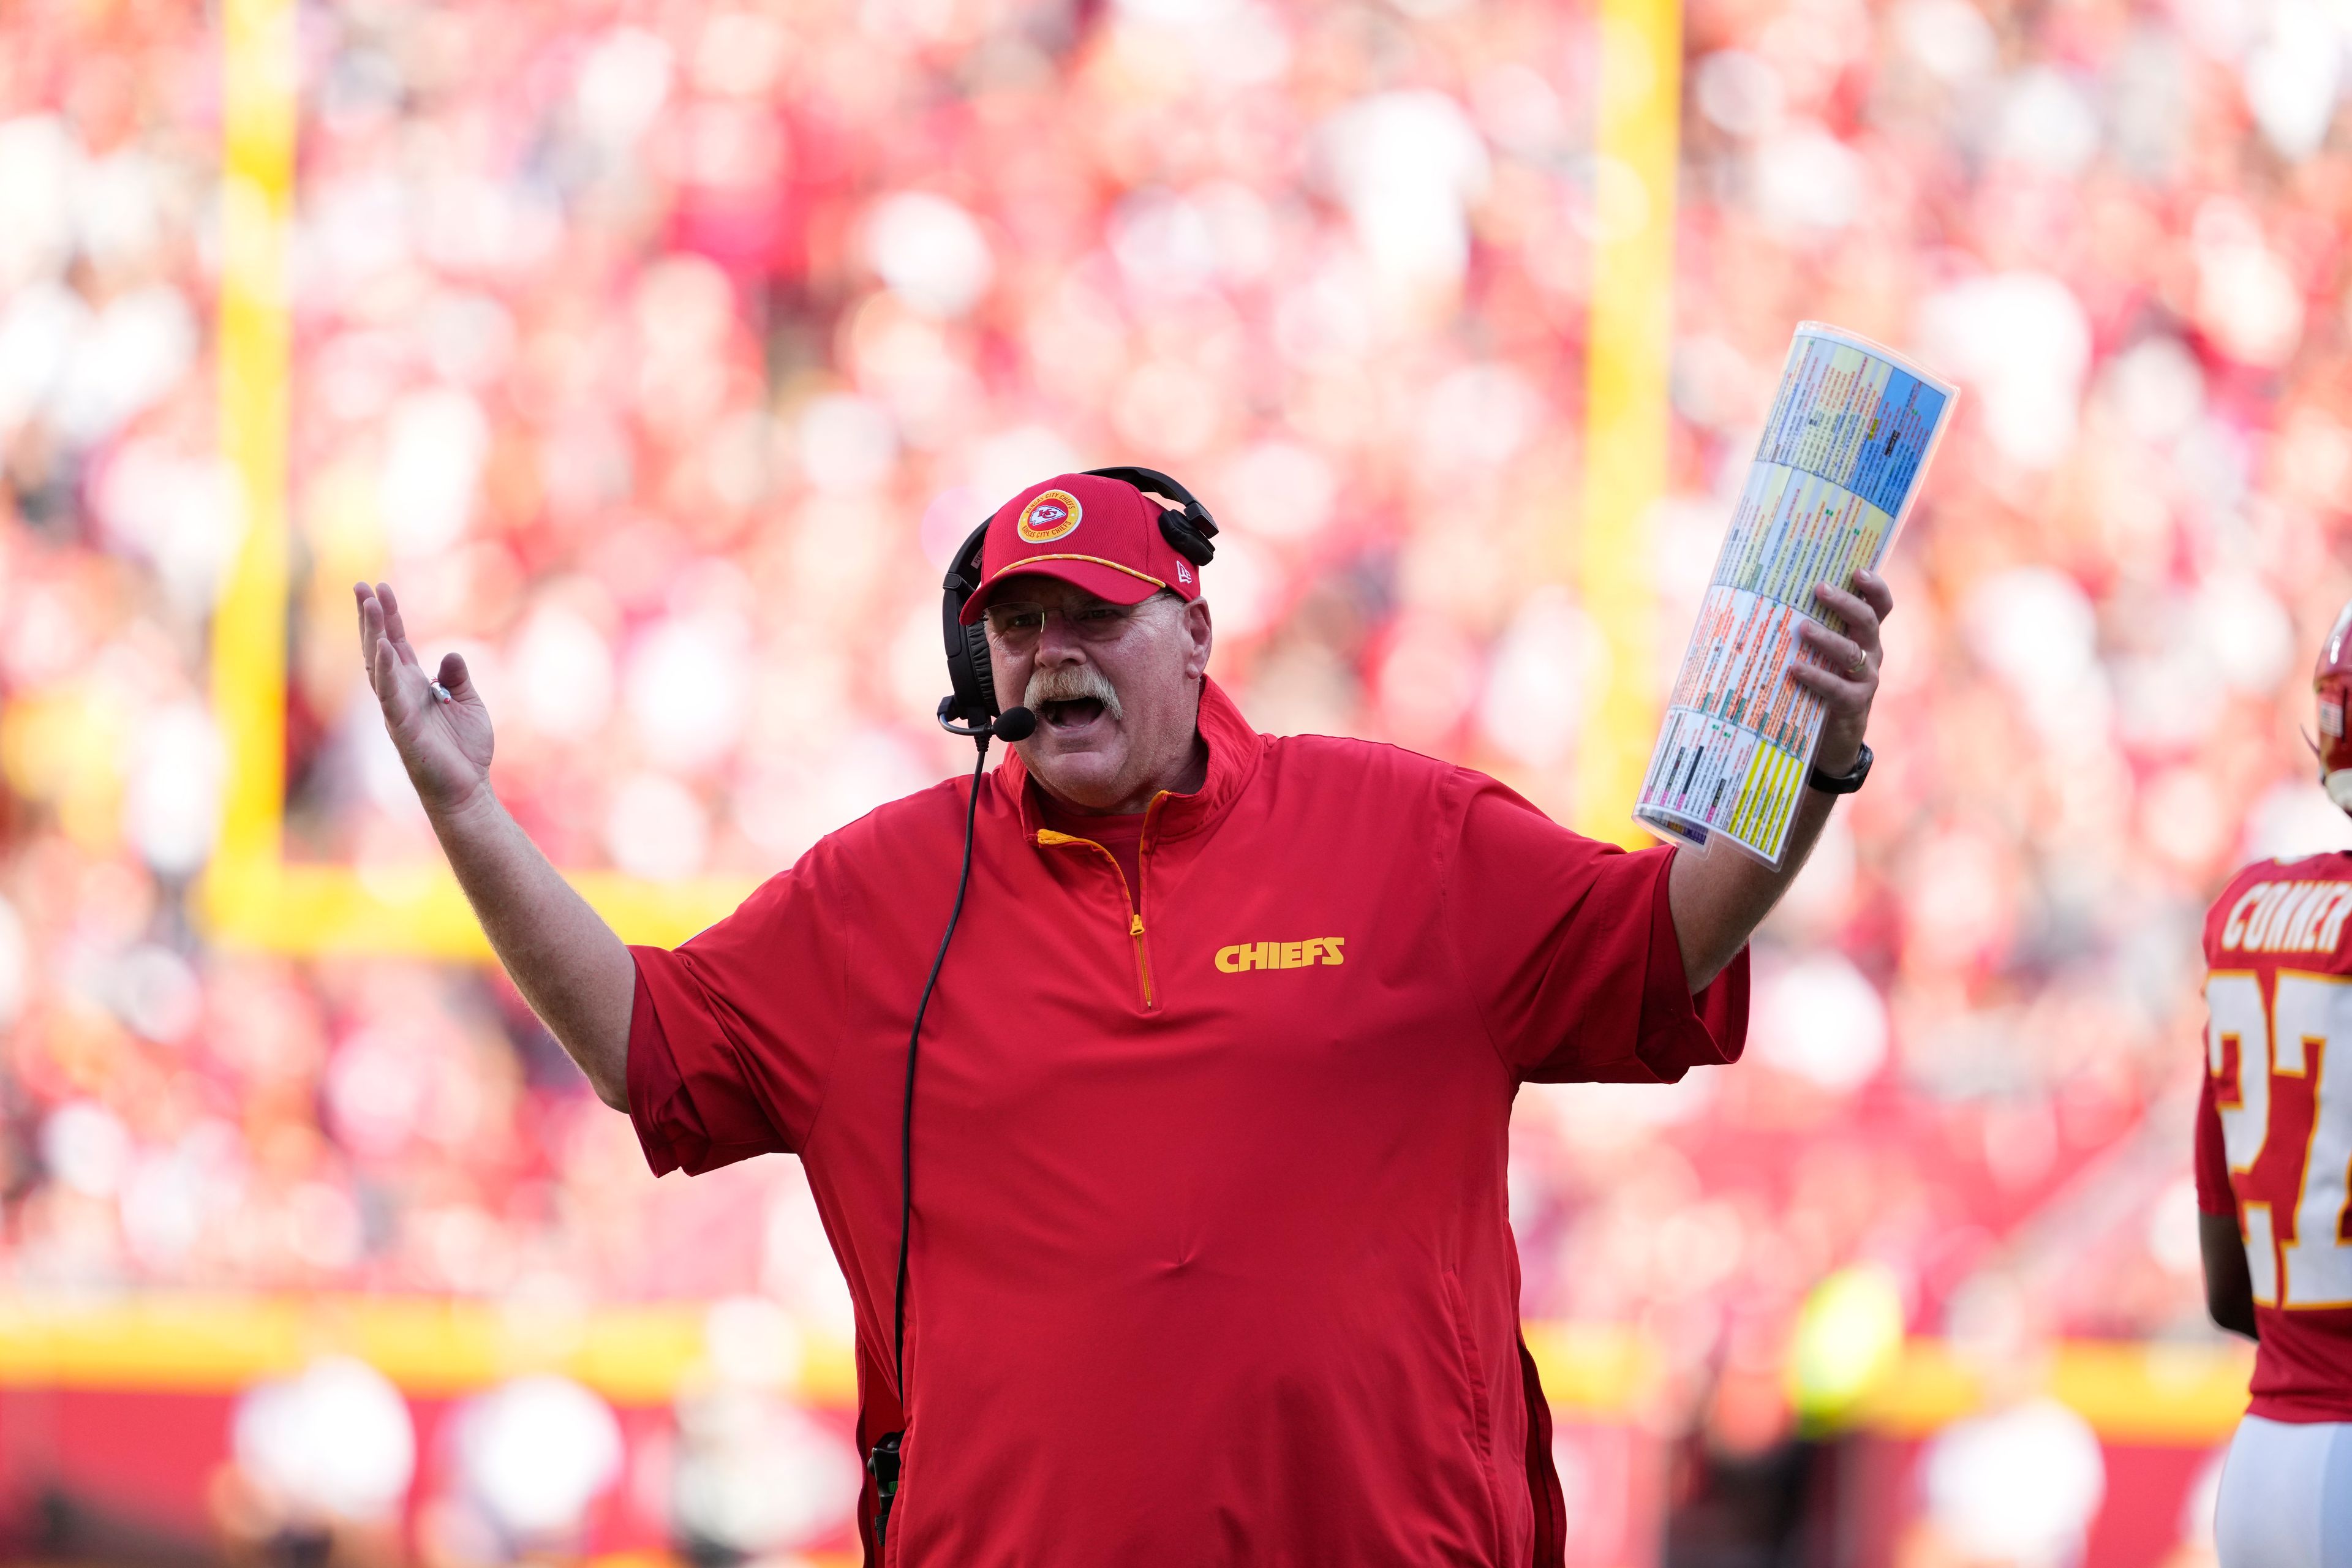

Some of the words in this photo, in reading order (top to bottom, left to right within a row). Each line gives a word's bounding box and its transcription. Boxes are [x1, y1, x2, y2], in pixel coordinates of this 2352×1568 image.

[1025, 496, 1044, 513] KANSAS
[1059, 494, 1075, 509] CHIEFS
[1022, 525, 1036, 538] KANSAS
[1051, 521, 1071, 535] CHIEFS
[1215, 937, 1344, 973] CHIEFS
[2206, 968, 2352, 1310] 27
